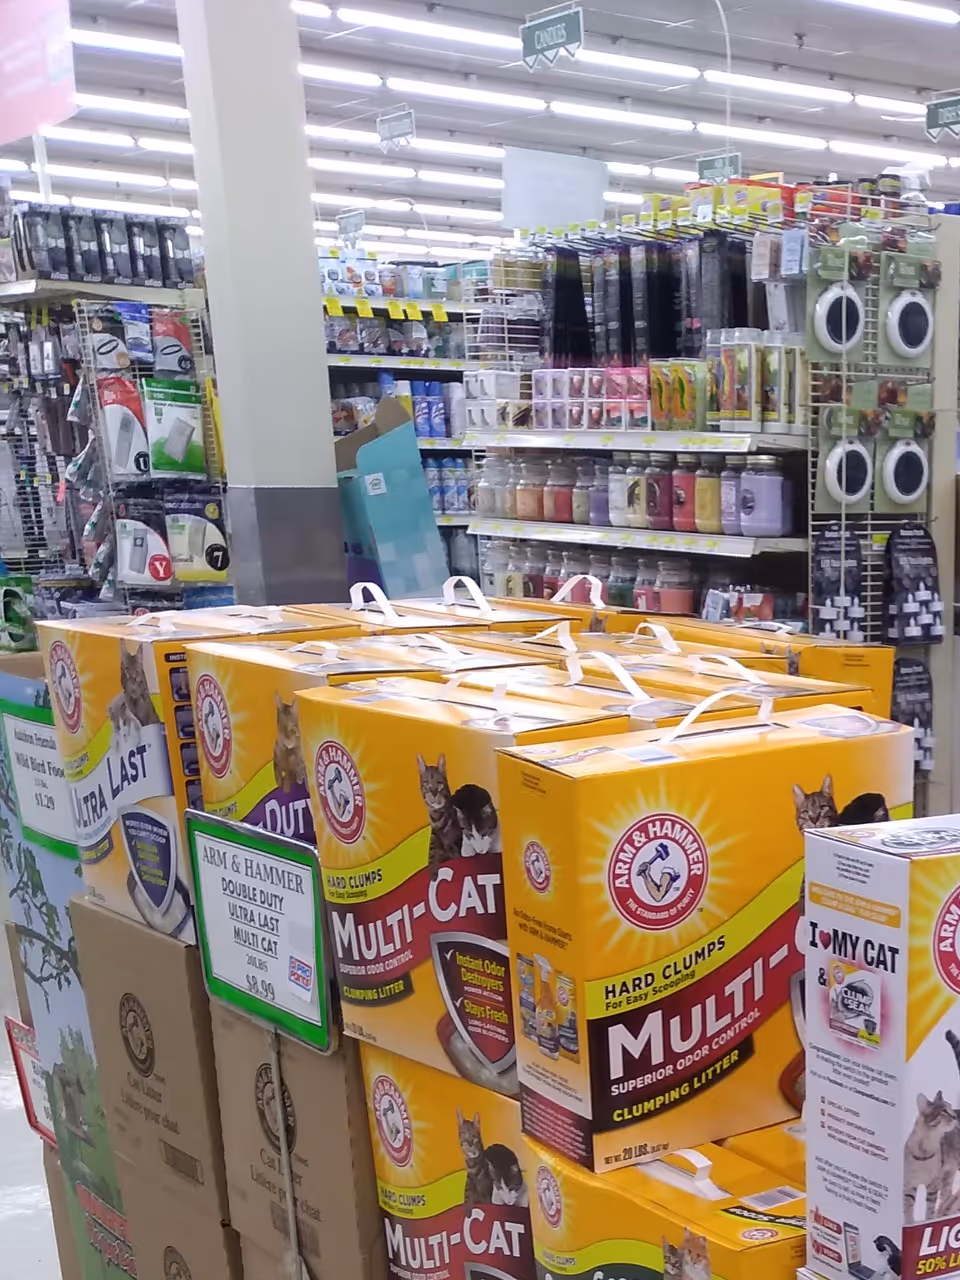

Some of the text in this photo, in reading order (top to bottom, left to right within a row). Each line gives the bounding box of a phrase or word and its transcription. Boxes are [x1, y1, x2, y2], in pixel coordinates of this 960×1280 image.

[155, 560, 167, 577] Y
[213, 552, 223, 568] 7
[30, 756, 45, 774] Bird
[72, 745, 147, 828] ULTRA LAST
[202, 845, 305, 895] ARM & HAMMER
[615, 821, 702, 888] ARM & HAMMER
[221, 877, 284, 912] DOUBLE DUTY
[327, 869, 383, 890] HARD CLUMPS
[228, 902, 280, 933] ULTRA LAST
[331, 867, 500, 960] MULTI-CAT
[233, 925, 278, 956] MULTI CAT
[809, 921, 900, 974] I MY CAT
[246, 953, 268, 973] 20LBS
[456, 952, 505, 977] Instant Odor
[604, 935, 726, 1001] HARD CLUMPS
[818, 967, 828, 986] &
[246, 974, 276, 1001] $8.99
[344, 980, 405, 1001] CLUMPING LITTER
[605, 969, 696, 1011] For Easy Scooping
[464, 1000, 508, 1024] Stays Fresh
[611, 1065, 674, 1096] SUPERIOR
[677, 1046, 709, 1071] ODOR
[711, 1007, 761, 1049] CONTROL
[612, 1050, 740, 1122] CLUMPING LITTER
[385, 1208, 525, 1269] MULTI-CAT
[916, 1255, 946, 1275] 50%
